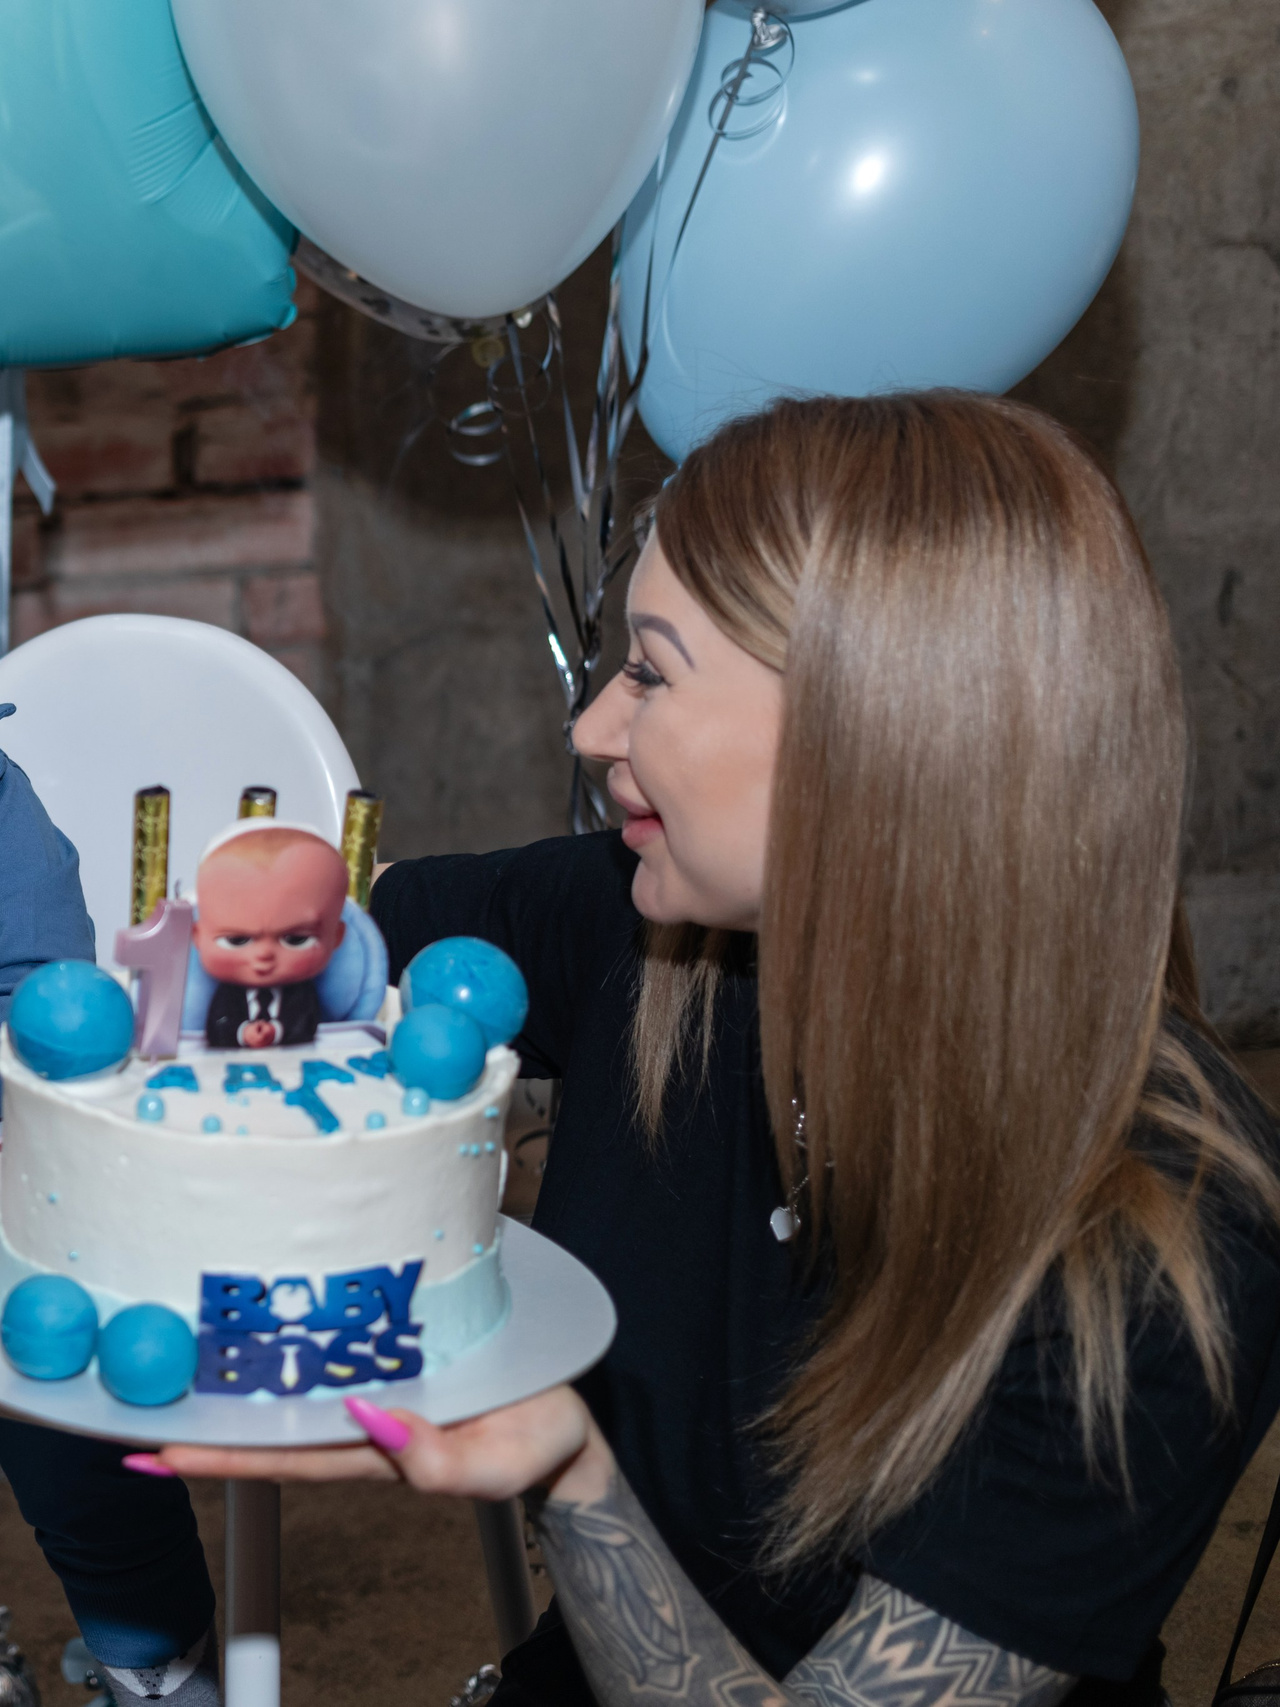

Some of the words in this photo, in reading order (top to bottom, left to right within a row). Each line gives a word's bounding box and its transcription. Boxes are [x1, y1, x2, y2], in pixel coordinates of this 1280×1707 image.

[113, 897, 193, 1061] 1
[199, 1258, 425, 1332] BABY
[194, 1323, 424, 1396] BOSS
